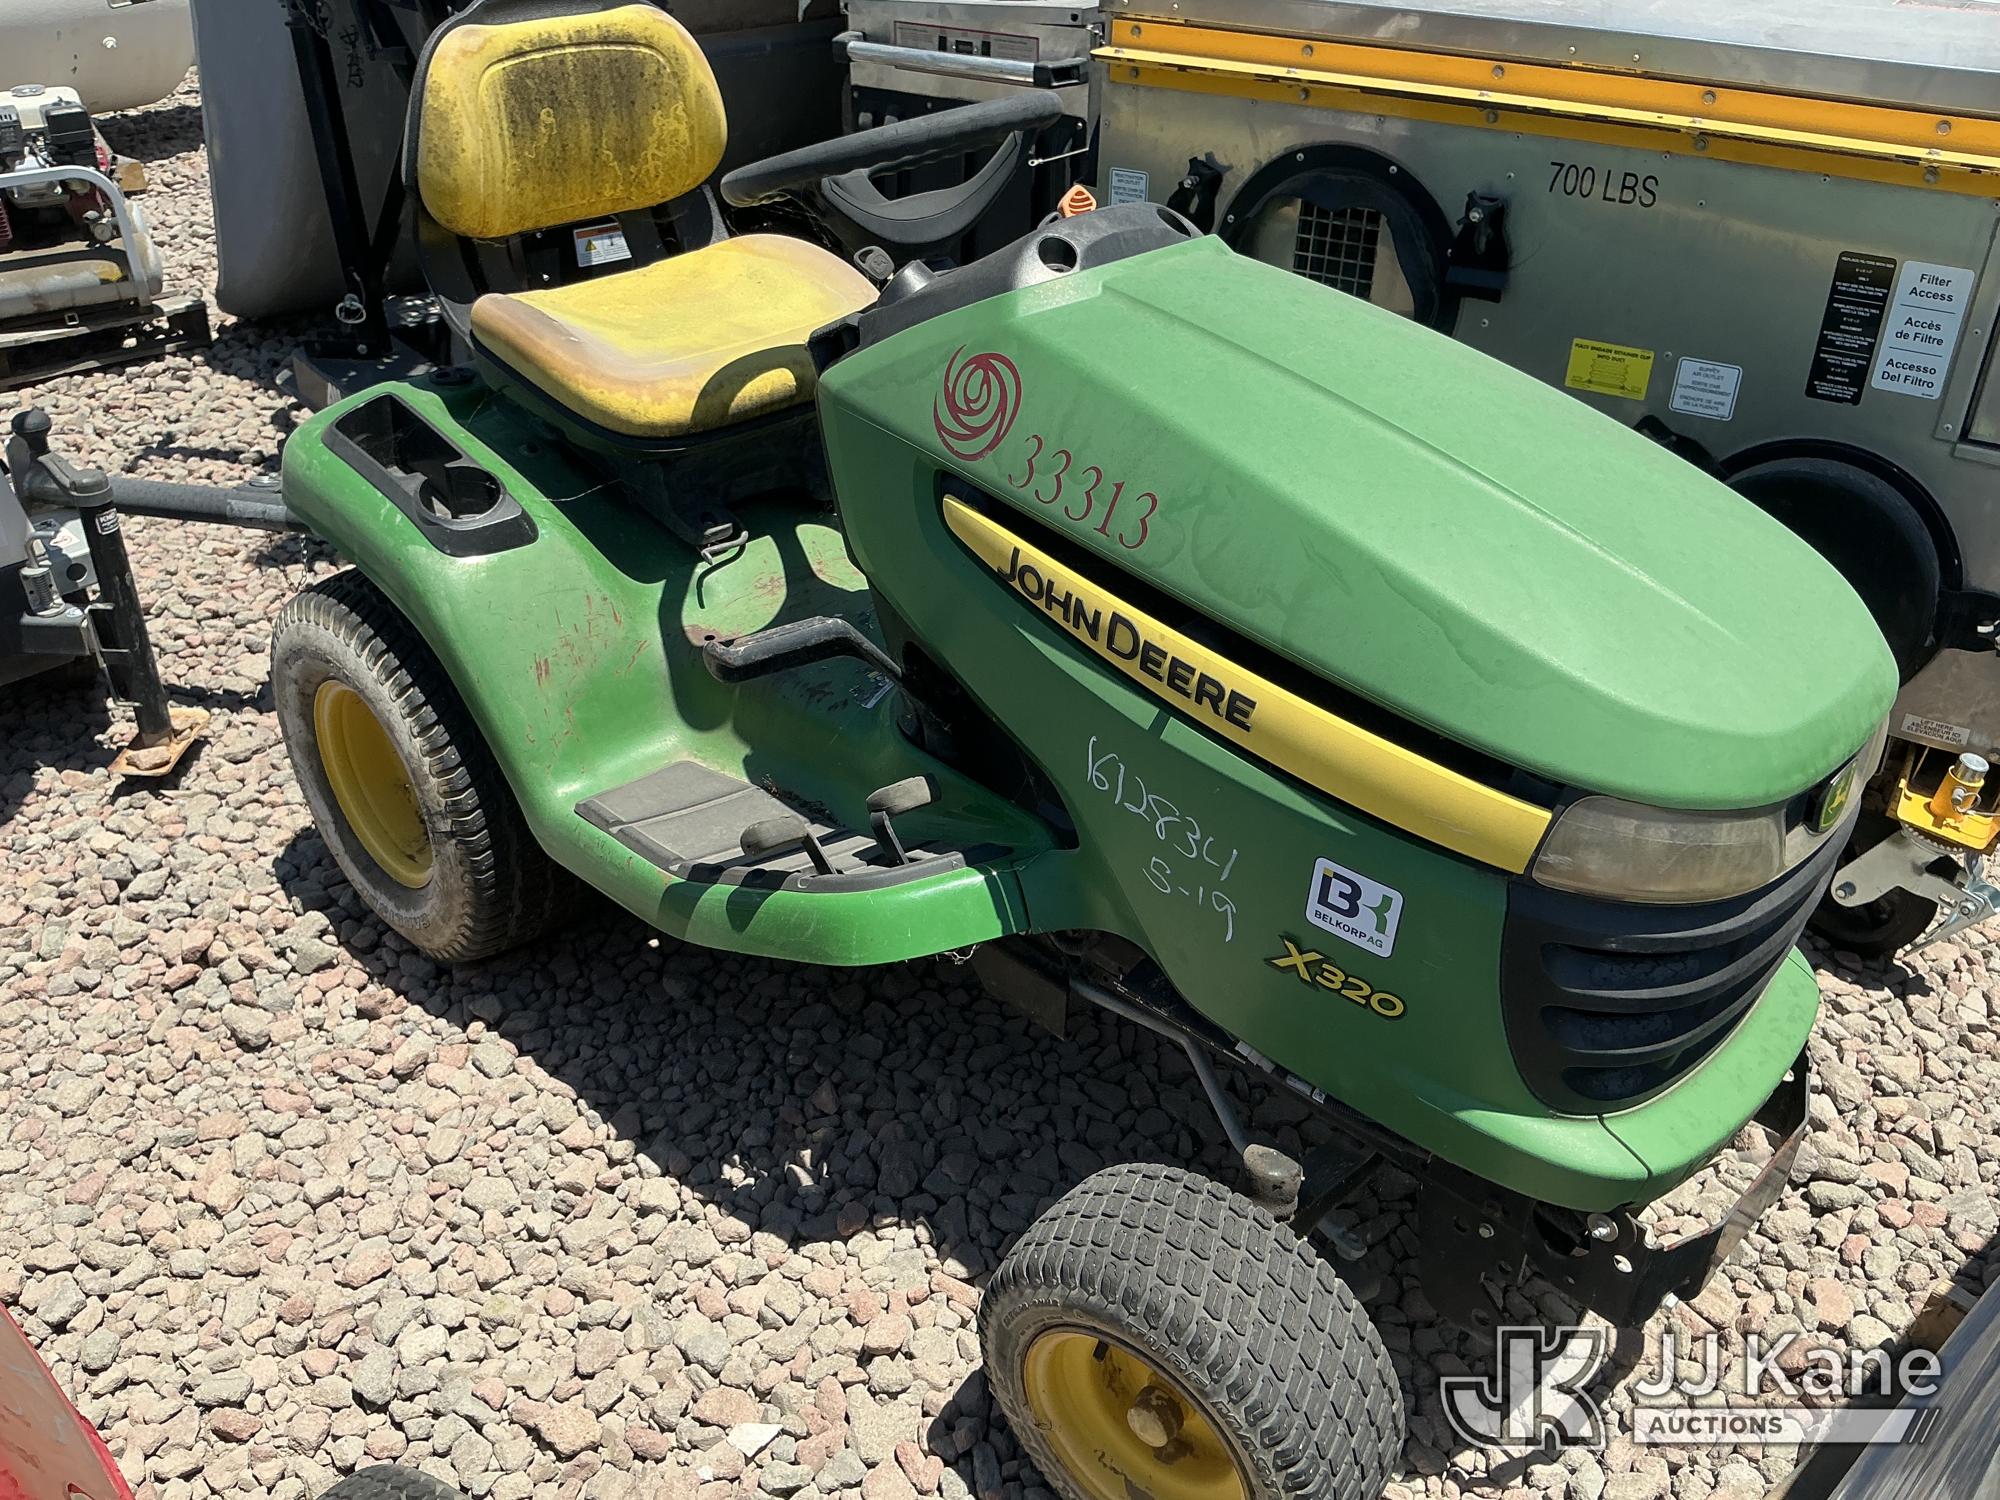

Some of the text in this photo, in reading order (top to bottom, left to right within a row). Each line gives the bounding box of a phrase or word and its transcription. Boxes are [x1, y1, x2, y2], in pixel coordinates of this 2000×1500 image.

[1549, 161, 1659, 208] 700 LBS
[1920, 273, 1952, 287] Filter
[1908, 286, 1954, 303] Access
[1903, 317, 1942, 331] Accès
[1895, 329, 1944, 346] de Filtre
[1885, 358, 1937, 375] Accesso
[1881, 371, 1935, 389] Del Filtro
[1007, 434, 1158, 550] 33313
[996, 546, 1258, 732] JOHN DEERE
[1910, 721, 1951, 736] ASCENSEUR
[1935, 722, 1954, 731] HERE
[1314, 909, 1384, 949] BELKORP AG
[1268, 937, 1406, 1019] X320
